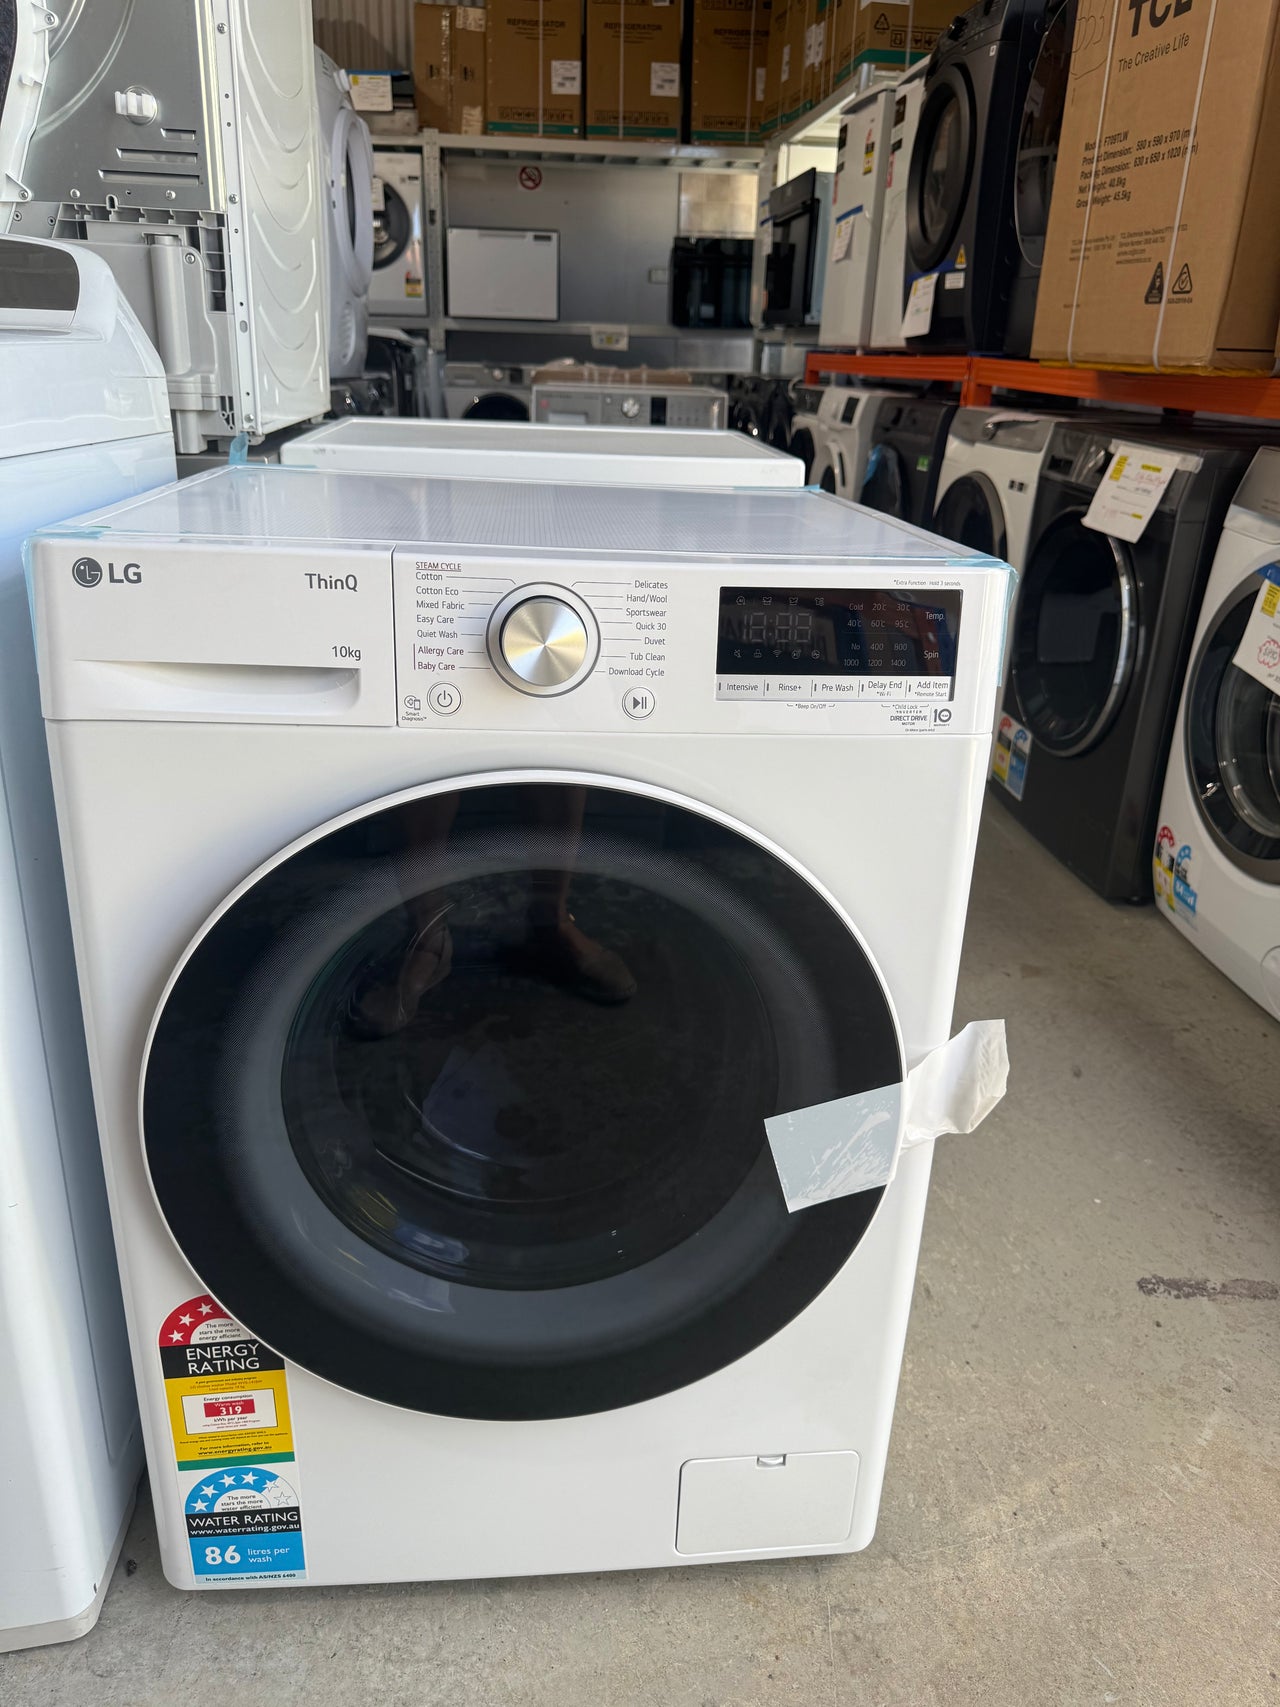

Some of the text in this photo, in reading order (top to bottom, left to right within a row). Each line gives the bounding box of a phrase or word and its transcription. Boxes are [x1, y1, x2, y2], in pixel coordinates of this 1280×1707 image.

[1118, 32, 1190, 73] The Creative Life
[416, 562, 462, 571] STEAM CYCLE
[109, 562, 142, 584] LG
[416, 572, 442, 581] Cotton
[305, 572, 358, 592] ThinQ
[634, 580, 668, 590] Delicates
[416, 586, 458, 596] Cotton Eco
[626, 594, 668, 604] Hand/Wool
[416, 600, 464, 610] Mixed Fabric
[626, 608, 666, 618] Sportswear
[926, 612, 944, 622] Temp.
[416, 615, 454, 624] Easy Care
[636, 622, 666, 632] Quick 30
[417, 630, 458, 640] Quiet Wash
[644, 637, 666, 646] Duvet
[332, 646, 361, 662] 10kg
[418, 646, 464, 656] Allergy Care
[924, 650, 938, 660] Spin
[630, 653, 666, 662] Tub Clean
[418, 662, 456, 672] Baby Care
[609, 668, 664, 678] Download Cycle
[726, 682, 758, 692] Intensive
[778, 683, 802, 692] Rinse+
[822, 684, 854, 692] Pre Wash
[868, 681, 902, 691] Delay End
[917, 681, 933, 689] Add
[934, 708, 952, 722] 10
[186, 1343, 260, 1360] ENERGY
[188, 1358, 260, 1374] RATING
[220, 1406, 242, 1416] 319
[198, 1446, 272, 1456] www.energyrating.gov.au
[190, 1512, 298, 1527] WATER RATING
[190, 1524, 300, 1536] www.waterrating.gov.au
[205, 1546, 240, 1565] 86
[274, 1548, 290, 1556] per
